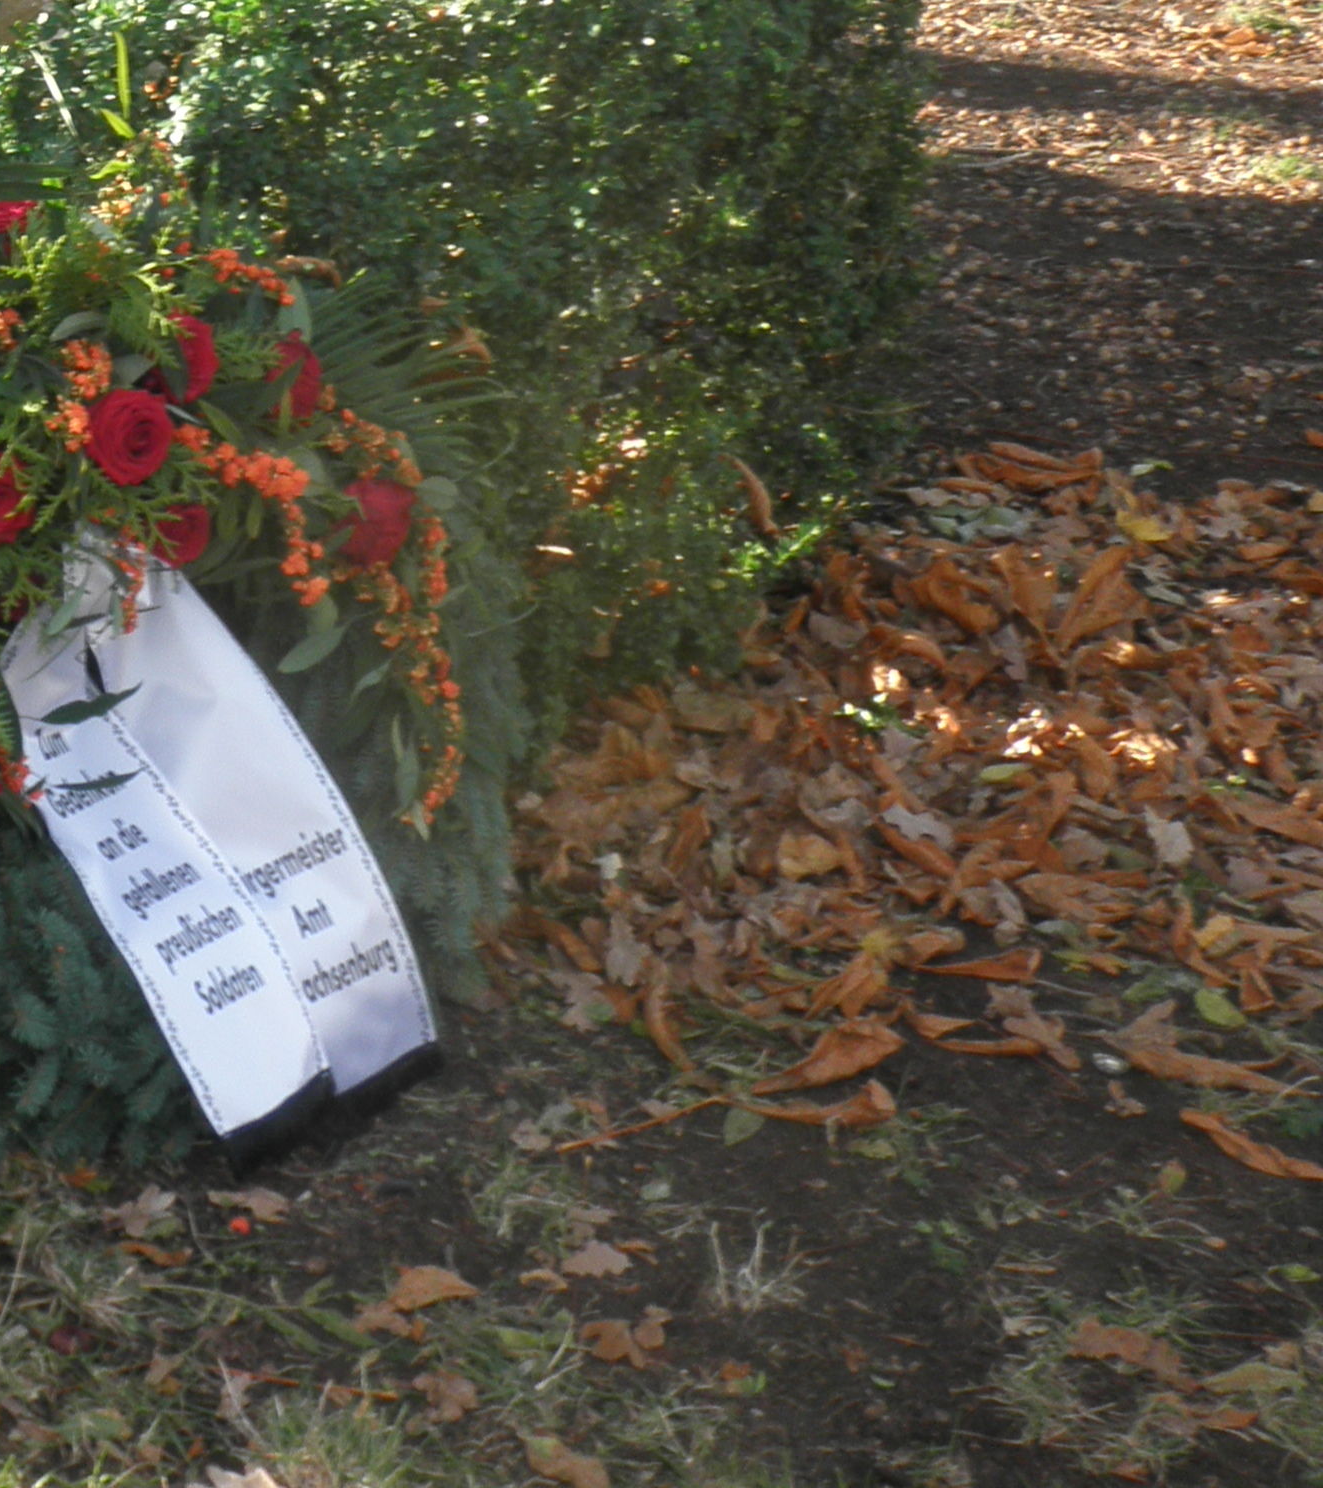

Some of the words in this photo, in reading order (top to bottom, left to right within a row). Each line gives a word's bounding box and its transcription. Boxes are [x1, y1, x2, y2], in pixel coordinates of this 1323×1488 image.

[35, 728, 70, 760] Zum
[96, 837, 125, 861] an
[112, 818, 148, 849] die
[290, 898, 334, 938] Amt
[193, 965, 266, 1014] Soldaten
[301, 939, 398, 1002] achsenburg
